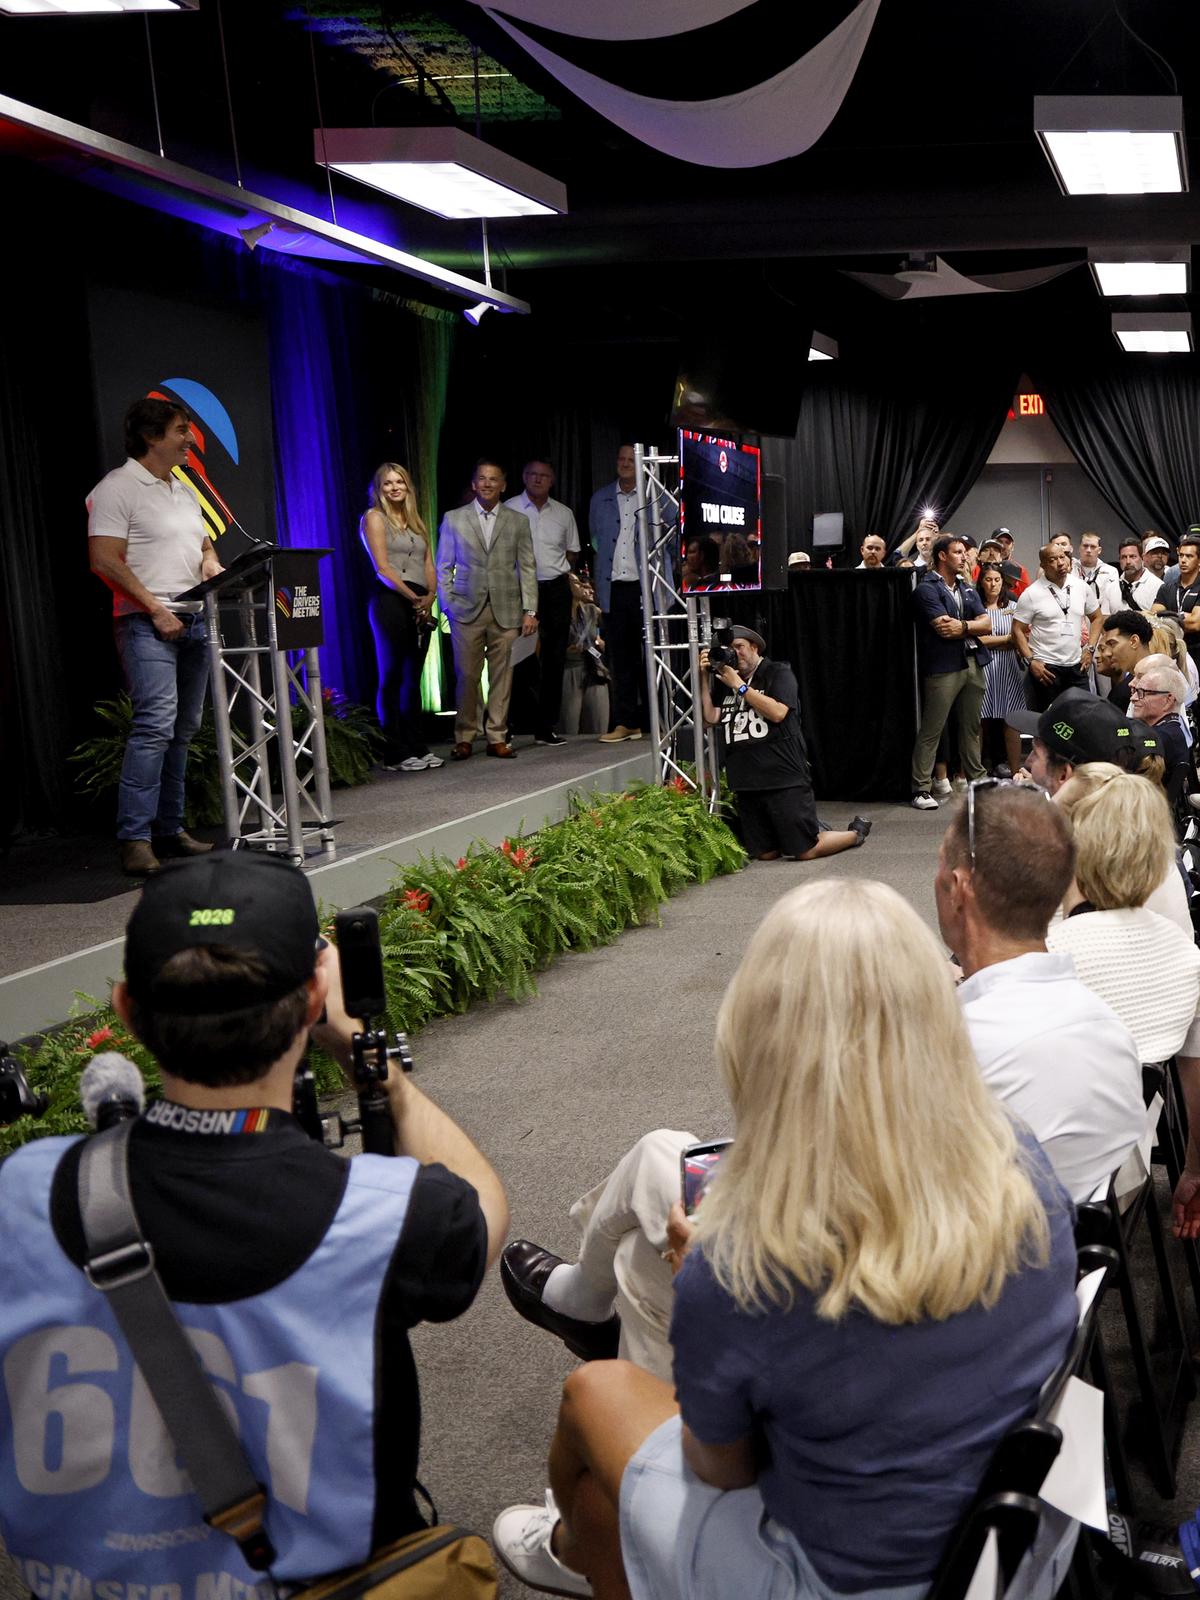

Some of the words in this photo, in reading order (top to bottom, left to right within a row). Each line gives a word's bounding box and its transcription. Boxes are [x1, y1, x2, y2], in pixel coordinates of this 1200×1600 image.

[701, 502, 720, 524] TOM
[720, 504, 746, 526] CRUISE
[294, 585, 308, 597] THE
[293, 595, 320, 608] DRIVERS
[292, 606, 320, 619] MEETING
[1053, 721, 1075, 741] 46
[146, 1100, 237, 1135] NASCAR
